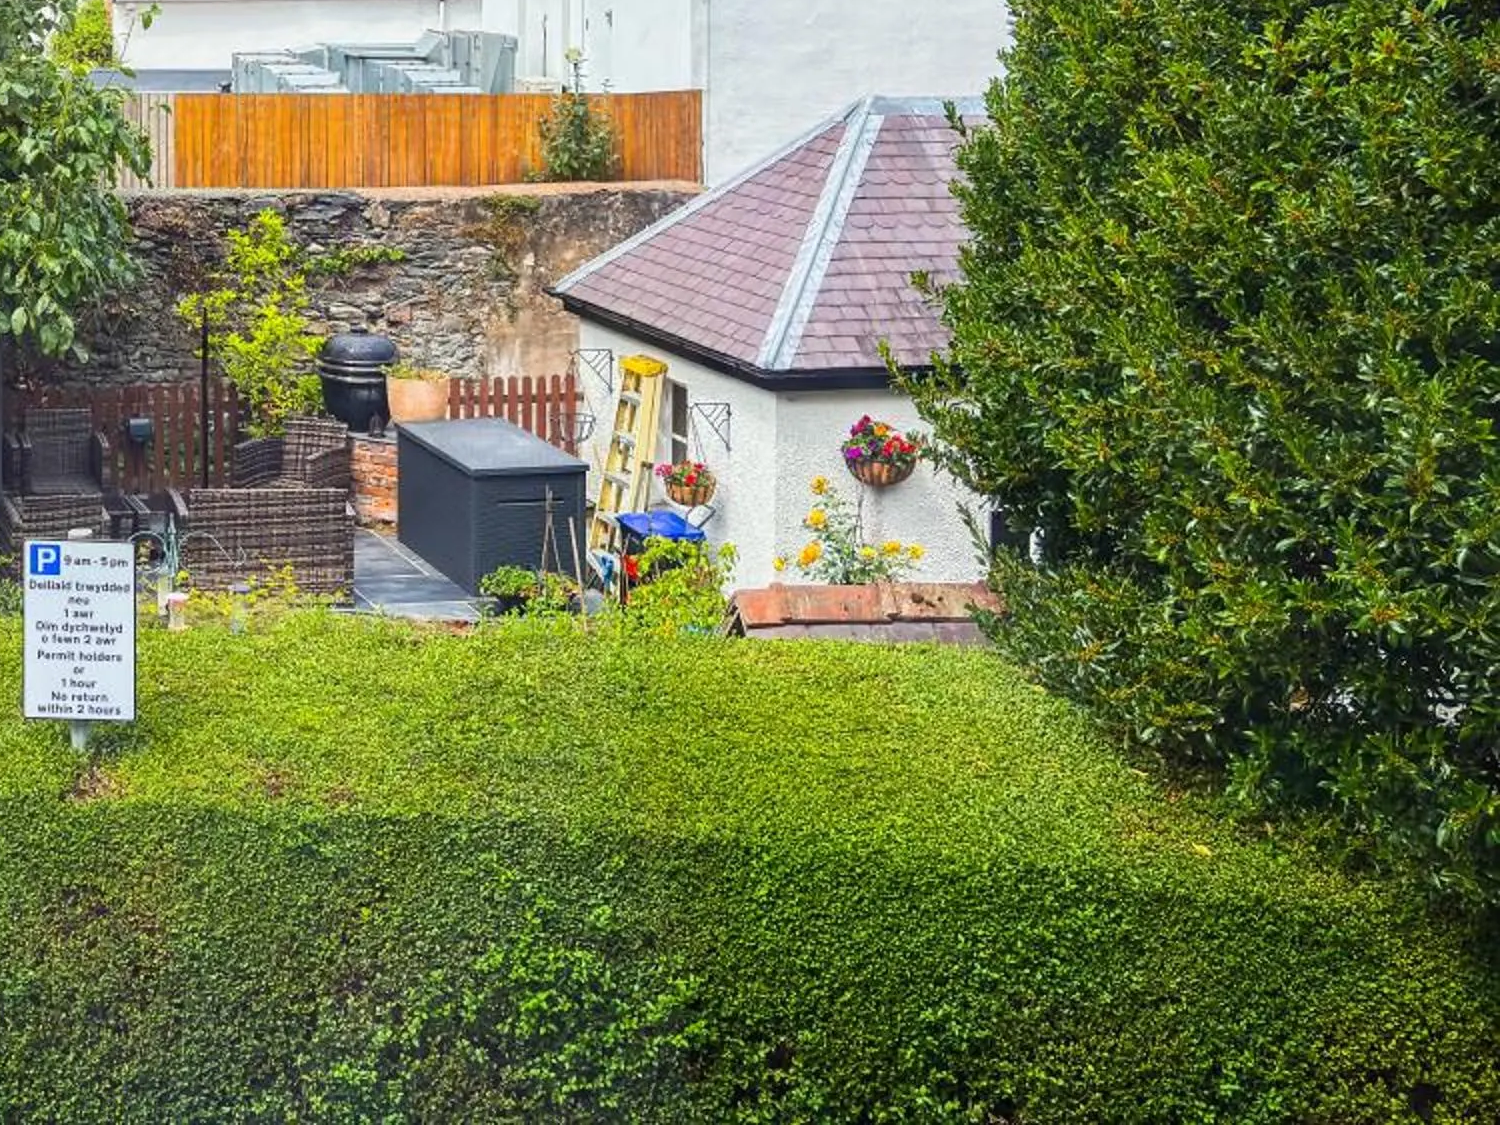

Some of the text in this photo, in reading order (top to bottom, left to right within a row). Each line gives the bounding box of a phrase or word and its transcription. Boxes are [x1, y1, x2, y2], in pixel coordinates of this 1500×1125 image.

[37, 548, 57, 572] P
[73, 610, 94, 618] awr
[61, 622, 123, 634] dychwelyd
[51, 634, 80, 643] fewn
[84, 635, 91, 644] 2
[95, 637, 116, 645] awr
[37, 650, 122, 662] Permit holders
[73, 666, 85, 674] or
[61, 678, 97, 688] 1 hour
[51, 691, 108, 701] No return
[38, 704, 121, 715] within 2 hours
